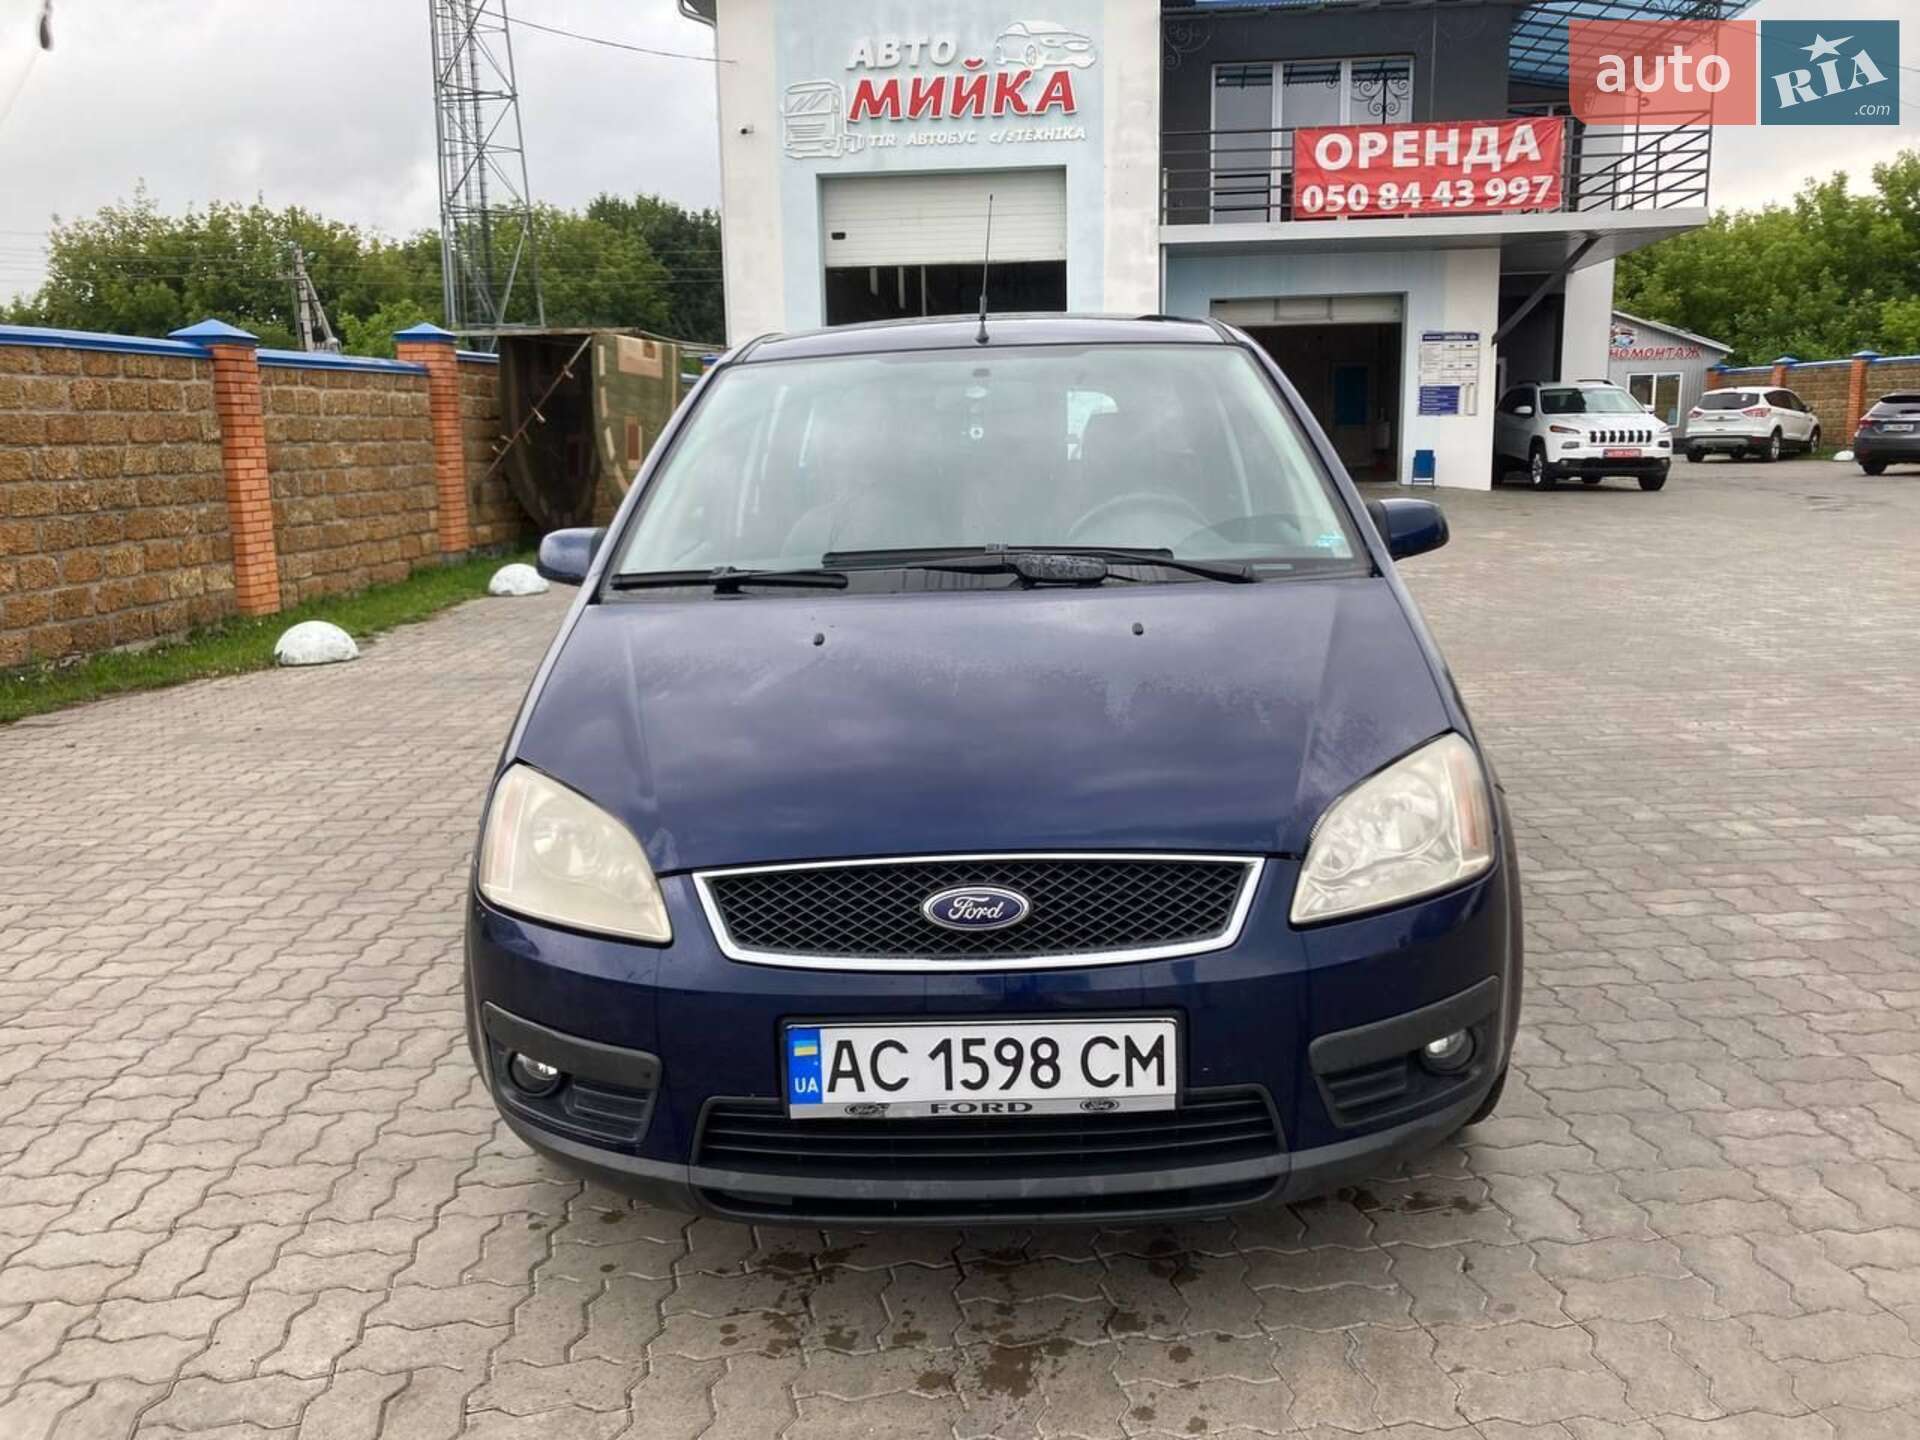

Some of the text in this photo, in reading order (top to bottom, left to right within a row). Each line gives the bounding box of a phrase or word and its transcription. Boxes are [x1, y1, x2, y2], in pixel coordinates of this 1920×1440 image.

[846, 34, 957, 68] АВТО
[848, 56, 1078, 122] МИЙКА
[906, 130, 977, 147] АВТОБУС
[1315, 124, 1542, 173] ОРЕНДА
[1302, 175, 1553, 212] 050 84 43 997
[947, 897, 1004, 920] Ford
[827, 1034, 1165, 1093] AC 1598 CM
[795, 1078, 818, 1094] UA
[930, 1103, 1033, 1114] FORD
